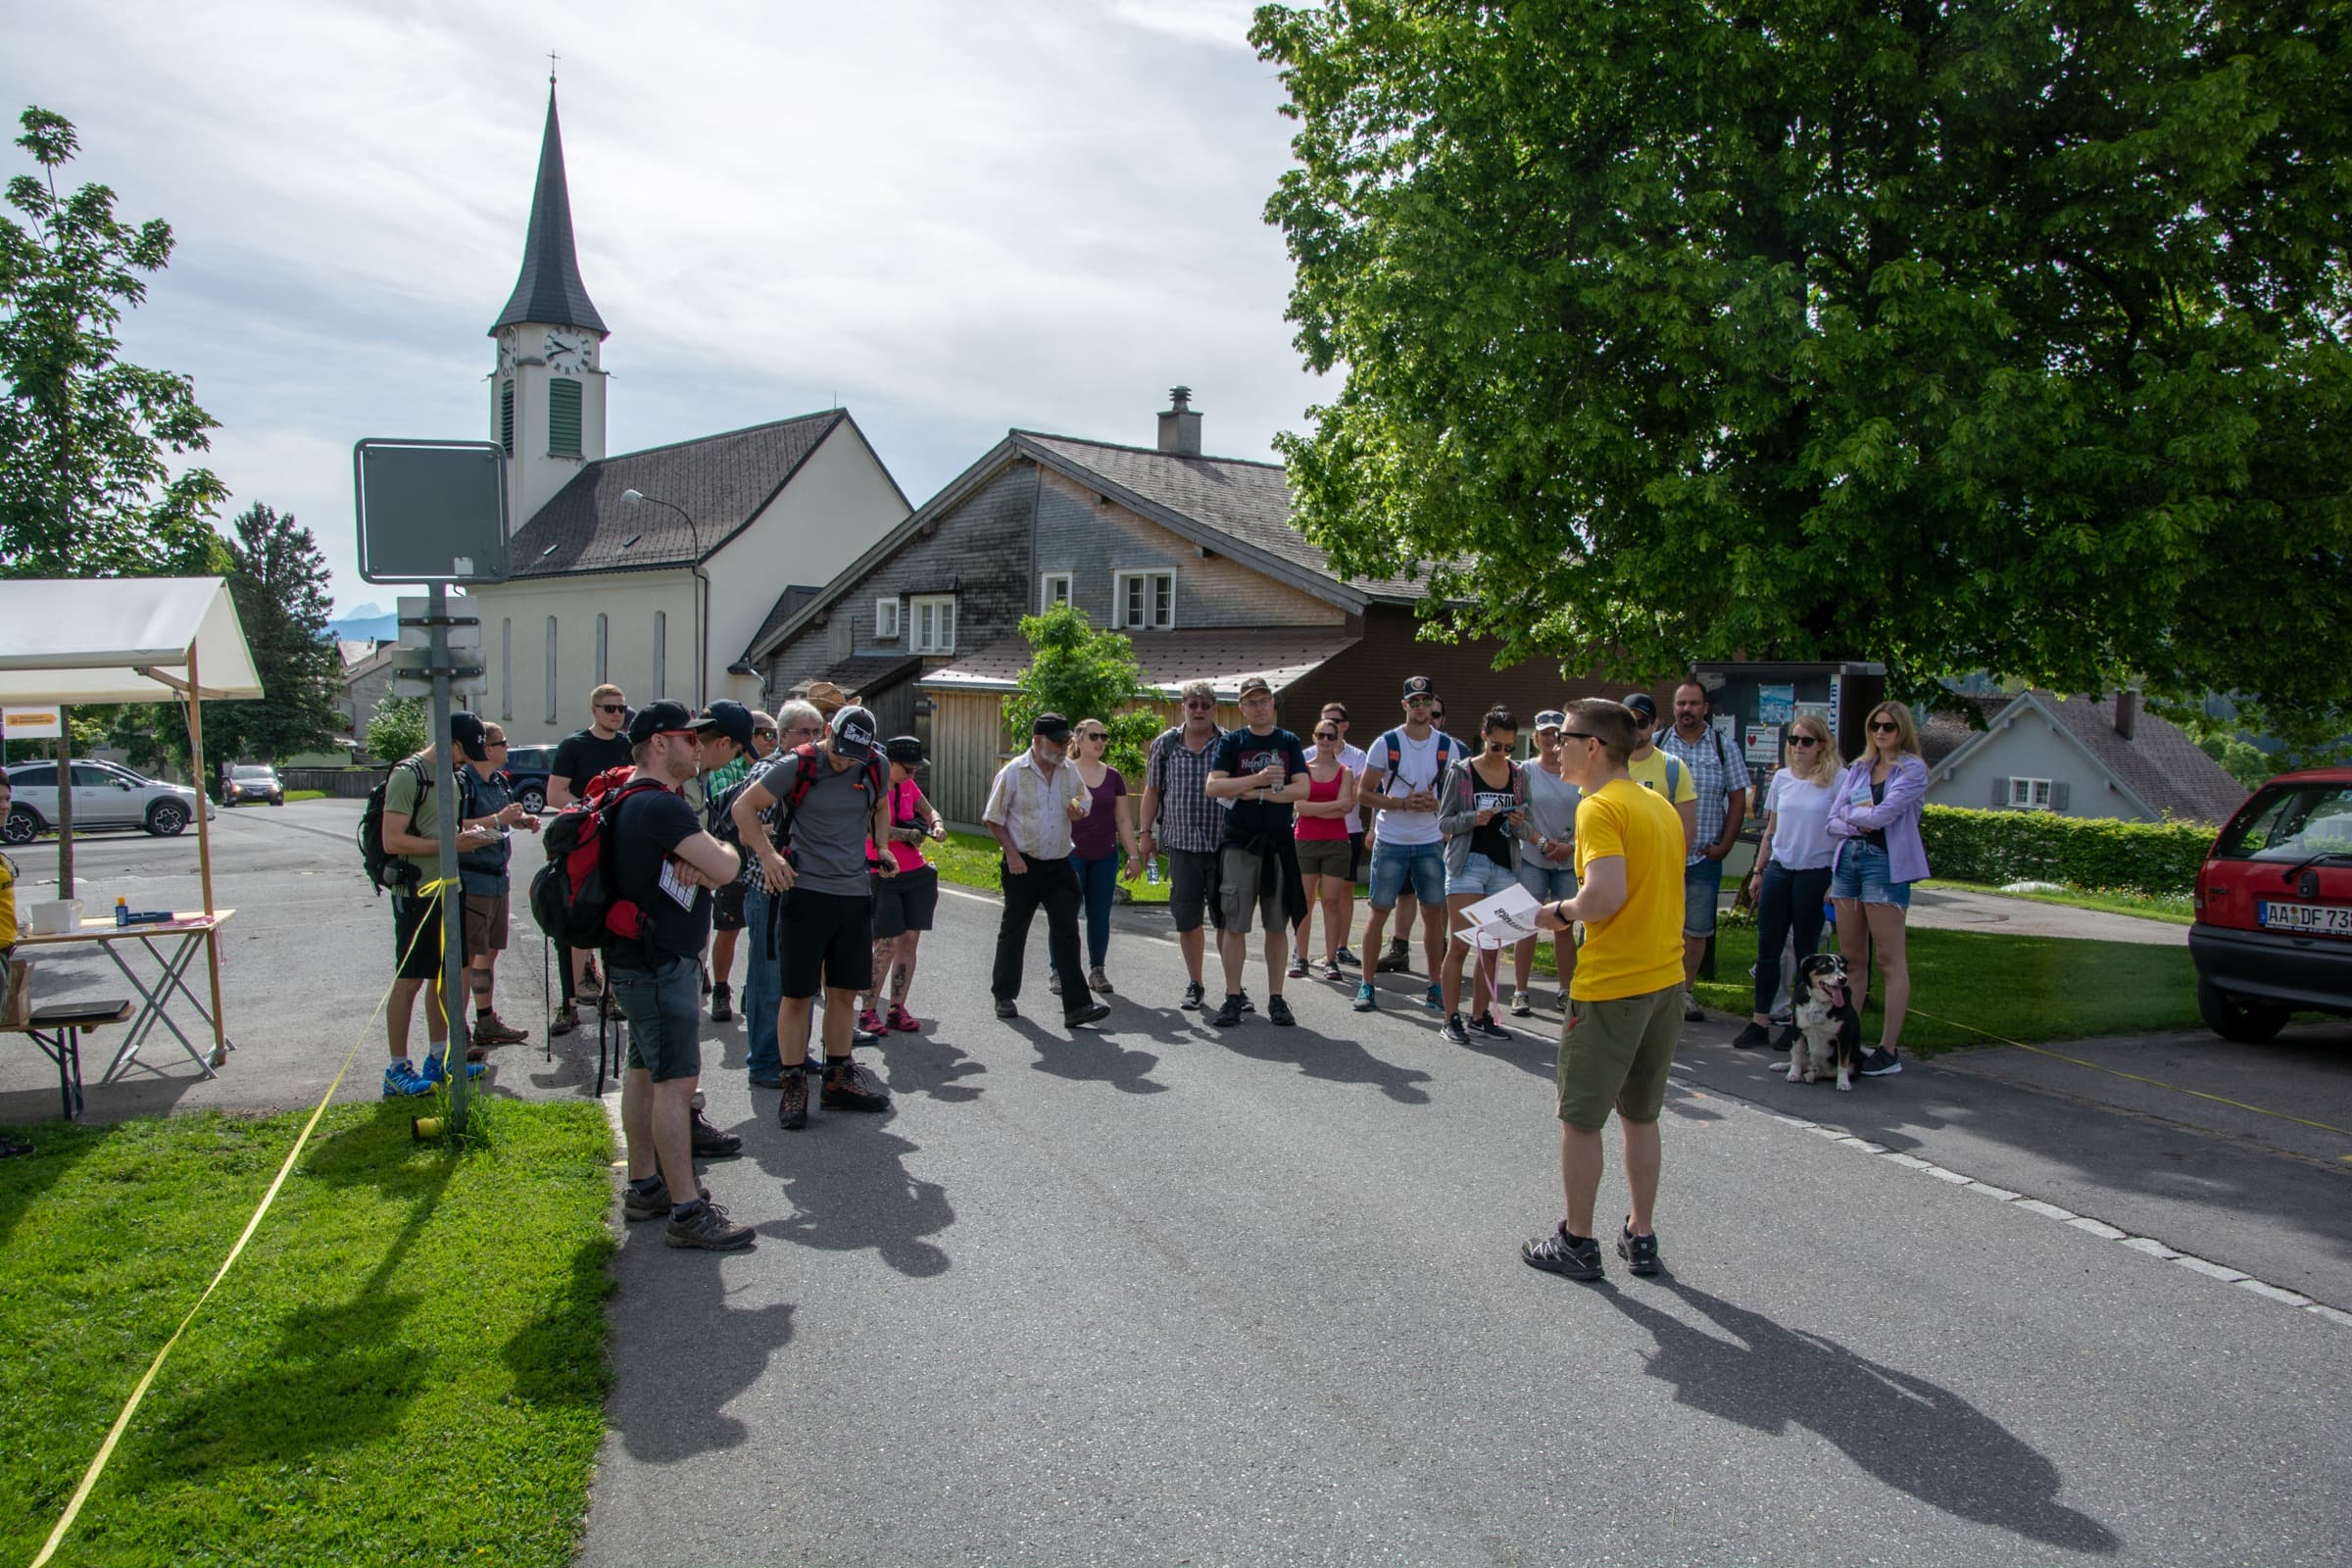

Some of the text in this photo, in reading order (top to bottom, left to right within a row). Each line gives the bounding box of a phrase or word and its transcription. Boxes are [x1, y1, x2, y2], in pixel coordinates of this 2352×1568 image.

[1241, 759, 1264, 768] Hard
[2269, 905, 2352, 928] AA DF 73
